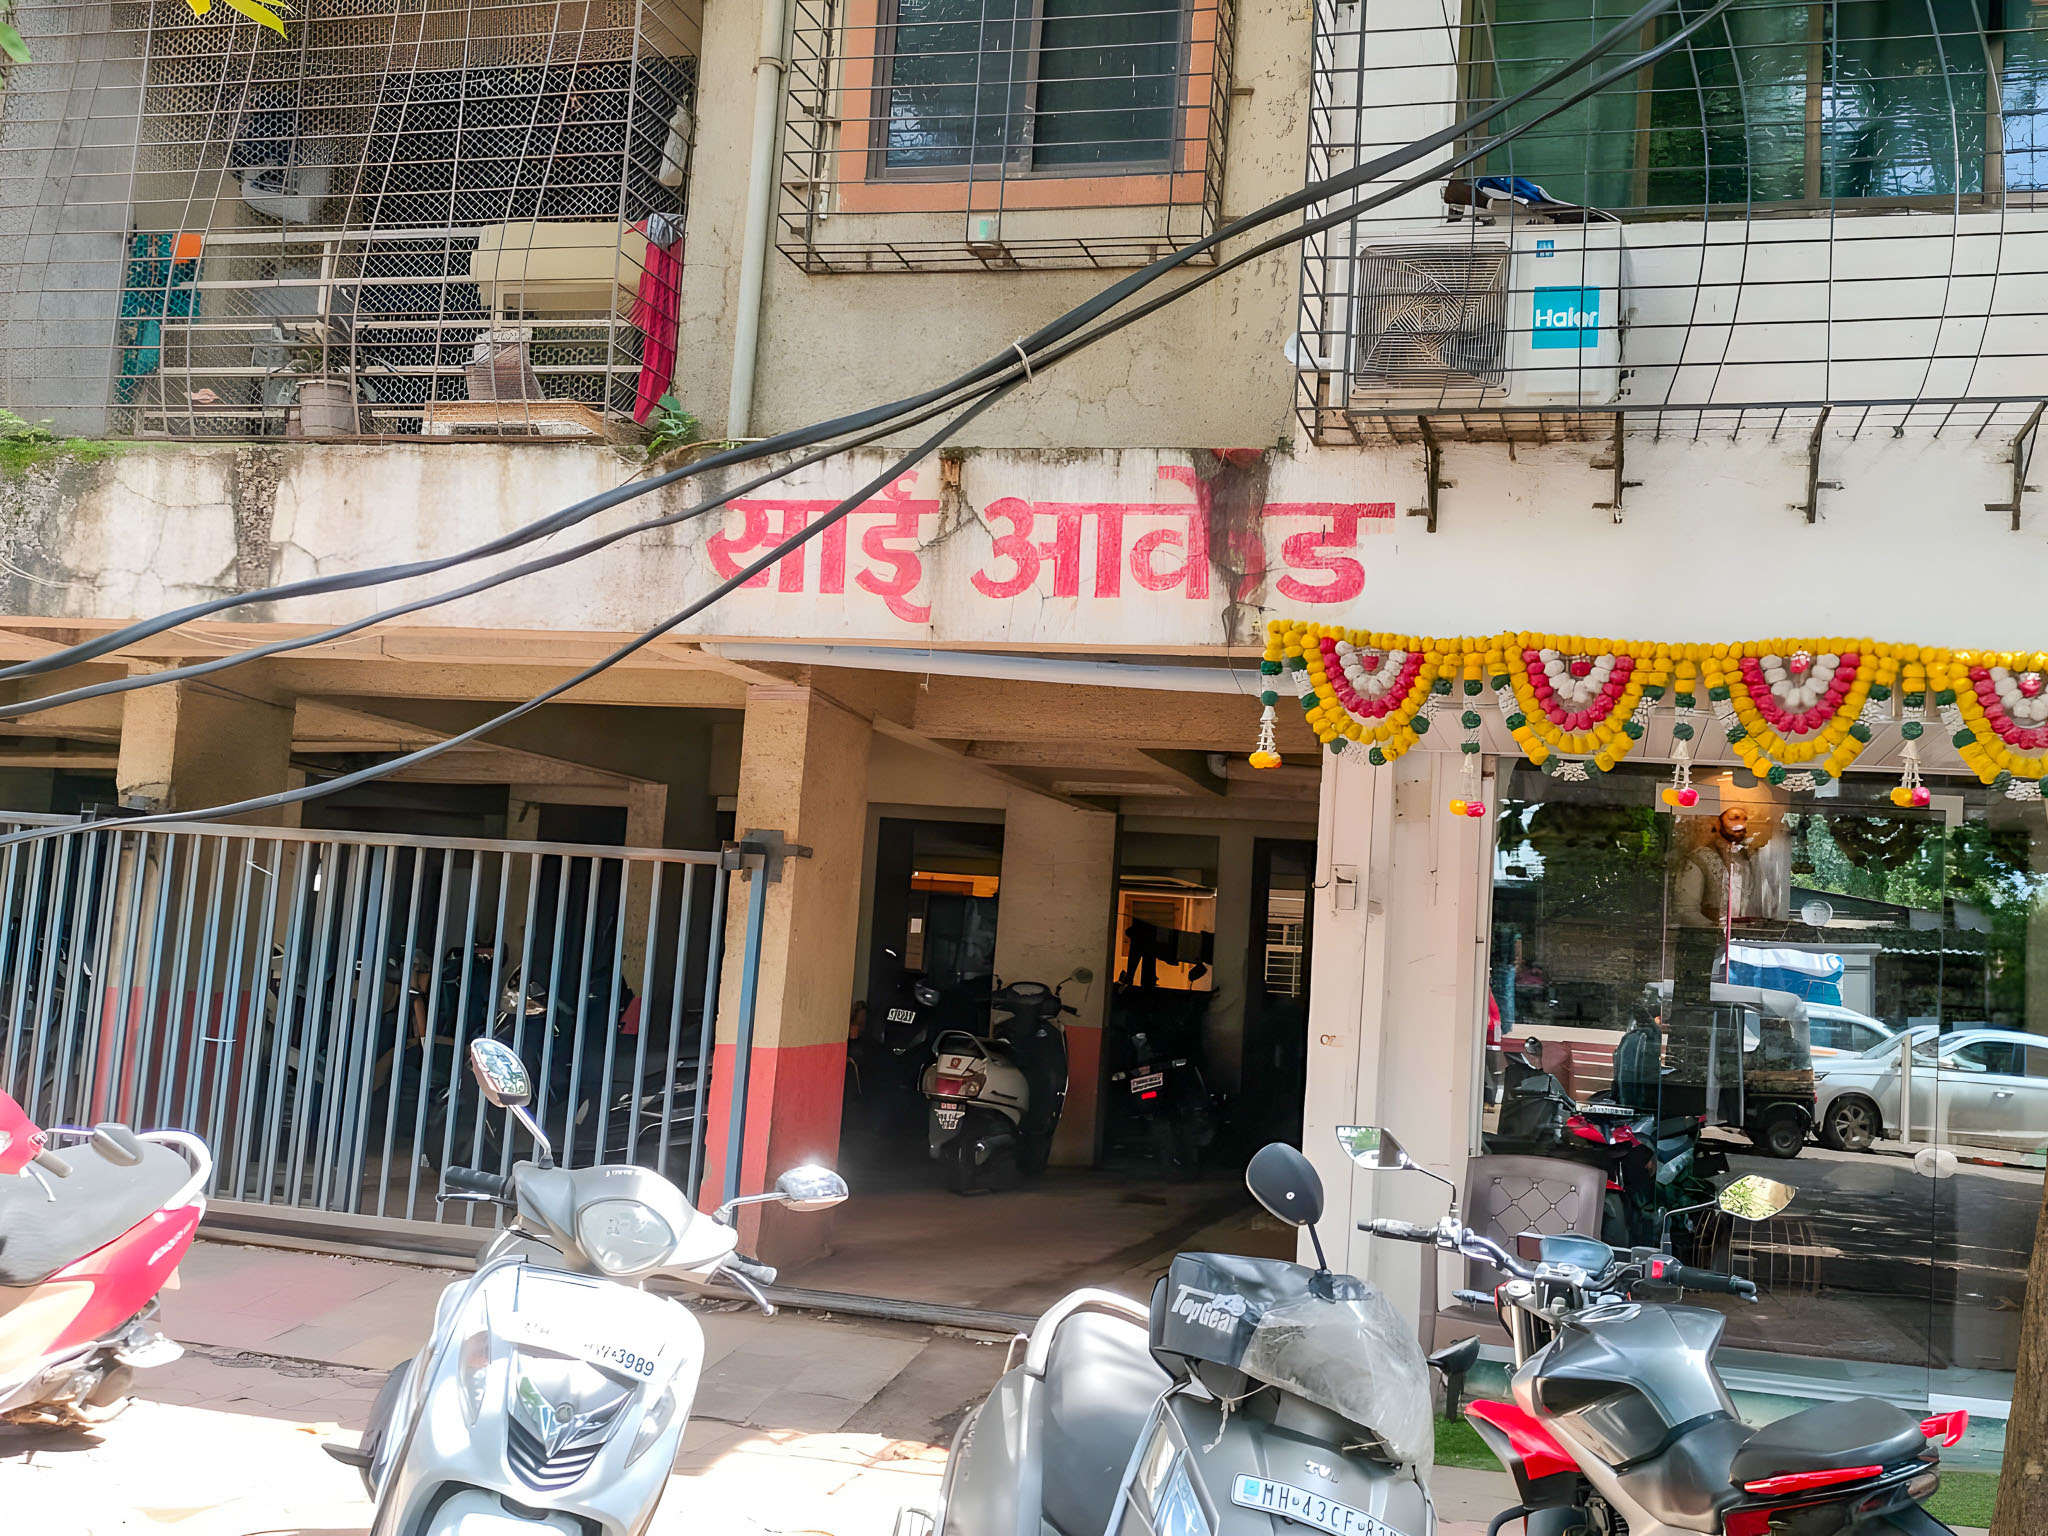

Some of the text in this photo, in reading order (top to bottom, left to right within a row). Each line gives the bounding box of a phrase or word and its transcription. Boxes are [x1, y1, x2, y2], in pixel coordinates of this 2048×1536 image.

[1535, 307, 1598, 328] Haier
[706, 470, 940, 623] साई
[1171, 1284, 1239, 1335] TopGear
[614, 1349, 655, 1377] 3989
